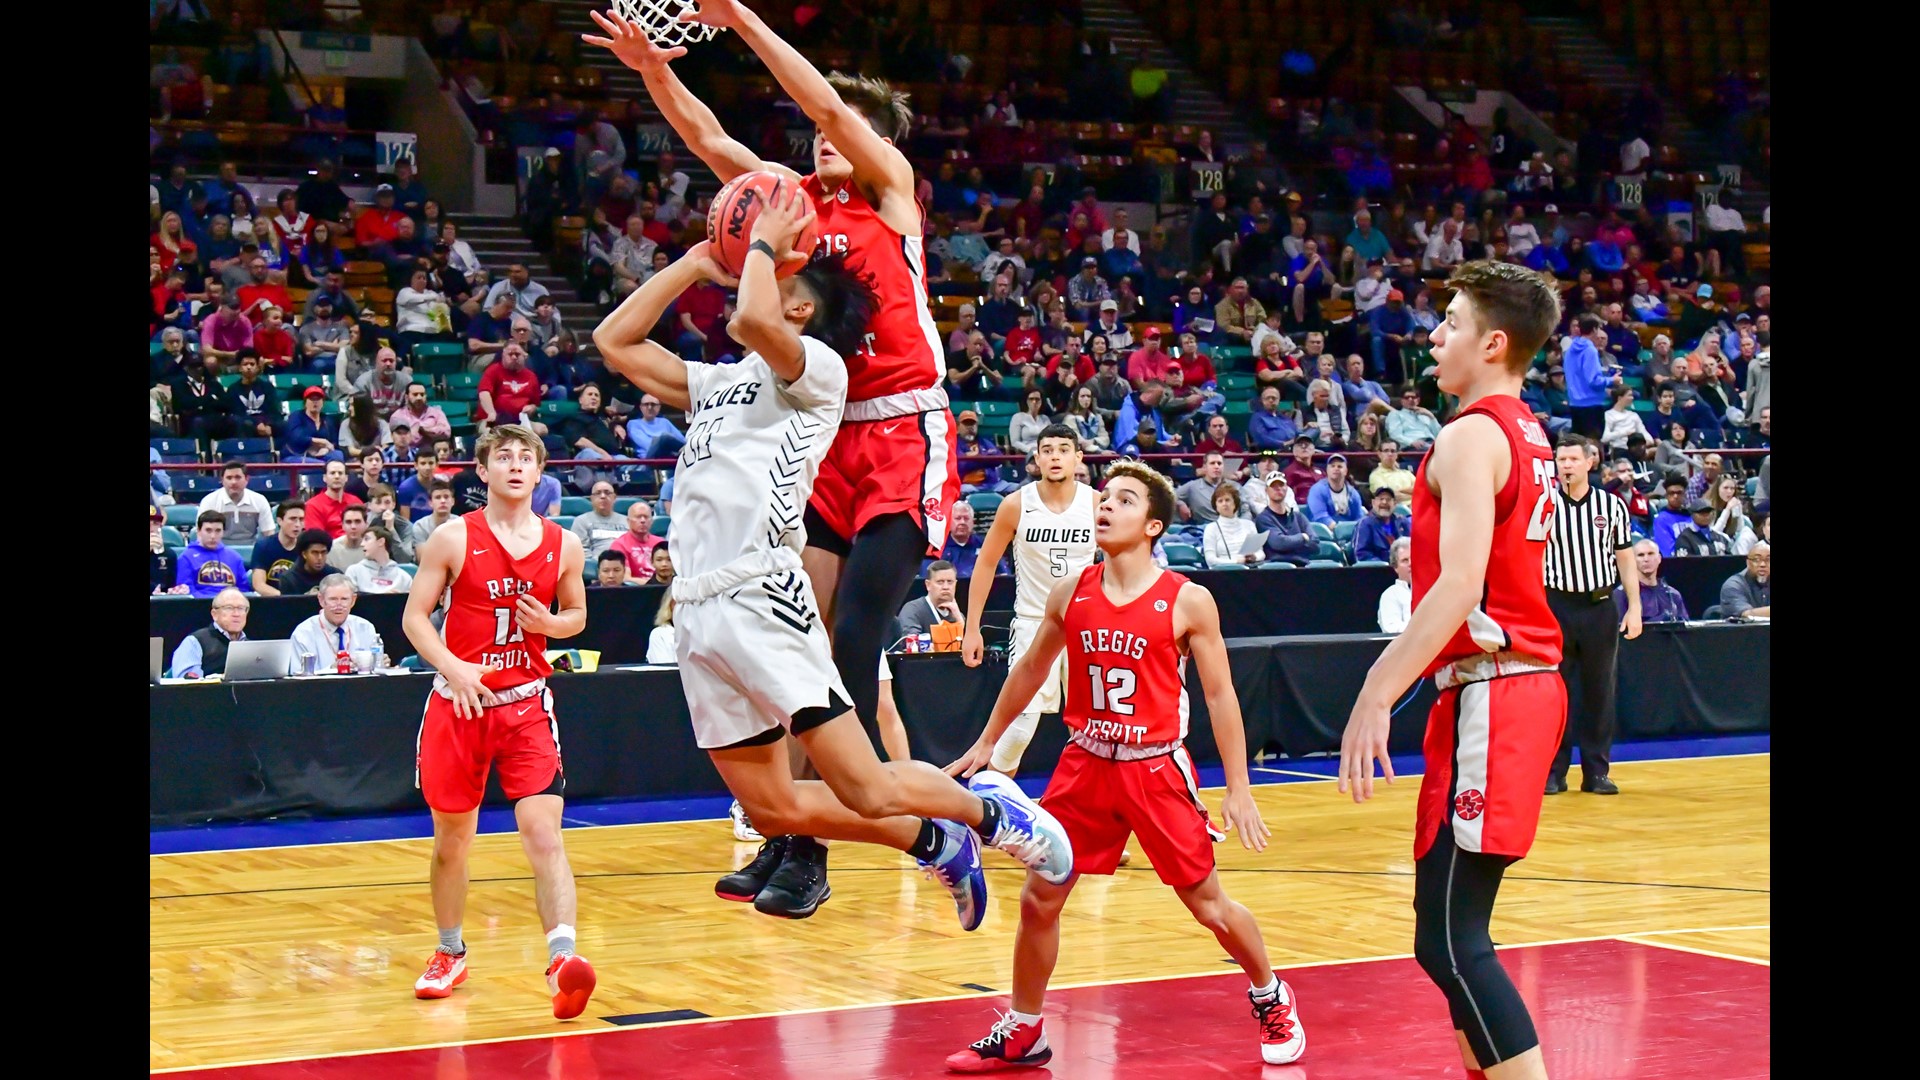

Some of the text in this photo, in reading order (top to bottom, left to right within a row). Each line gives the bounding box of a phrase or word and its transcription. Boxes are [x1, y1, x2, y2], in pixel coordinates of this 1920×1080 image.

[1198, 170, 1223, 191] 128
[1620, 183, 1643, 204] 128
[727, 187, 756, 240] NCAA
[1025, 528, 1091, 543] WOLVES
[1049, 548, 1068, 578] 5
[1080, 628, 1148, 660] REGIS
[1088, 664, 1137, 716] 12
